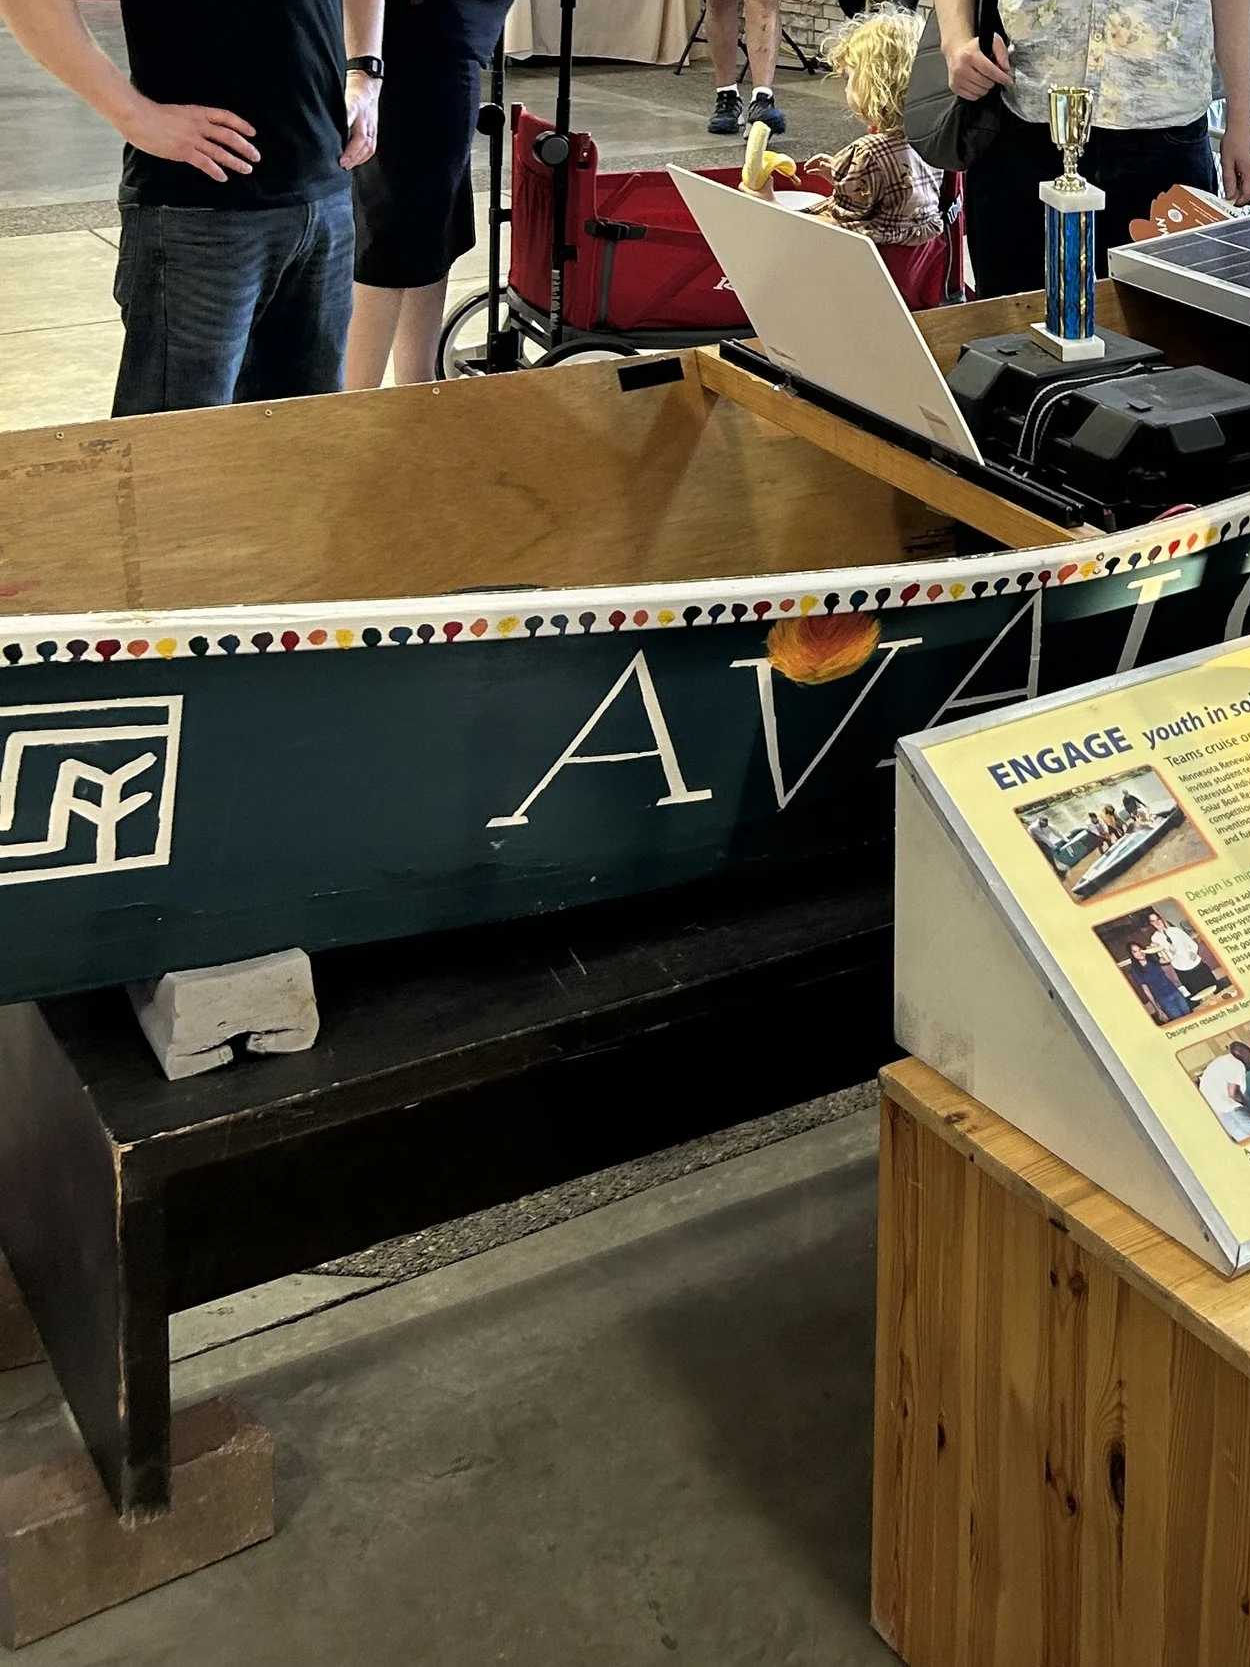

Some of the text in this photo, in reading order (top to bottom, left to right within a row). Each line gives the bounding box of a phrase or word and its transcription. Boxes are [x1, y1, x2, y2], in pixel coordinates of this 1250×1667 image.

[988, 727, 1132, 789] ENGAGE
[1142, 711, 1204, 750] youth
[1203, 706, 1228, 724] in
[1163, 749, 1203, 766] Teams
[1204, 737, 1239, 754] cruise
[1178, 765, 1220, 782] Minnesota
[1185, 780, 1213, 793] invites
[1192, 783, 1233, 803] interested
[1199, 801, 1221, 814] Solar
[1220, 795, 1240, 807] Boat
[1223, 832, 1240, 845] and
[1184, 882, 1223, 901] Design
[1220, 877, 1233, 888] is
[1197, 898, 1235, 916] Designing
[1204, 909, 1235, 926] requires
[1218, 930, 1243, 944] design
[1222, 943, 1240, 953] The
[1236, 966, 1246, 974] is
[1165, 1021, 1199, 1039] Designers
[1199, 1010, 1227, 1025] research
[1225, 1003, 1240, 1014] hull
[1243, 1147, 1250, 1156] A
